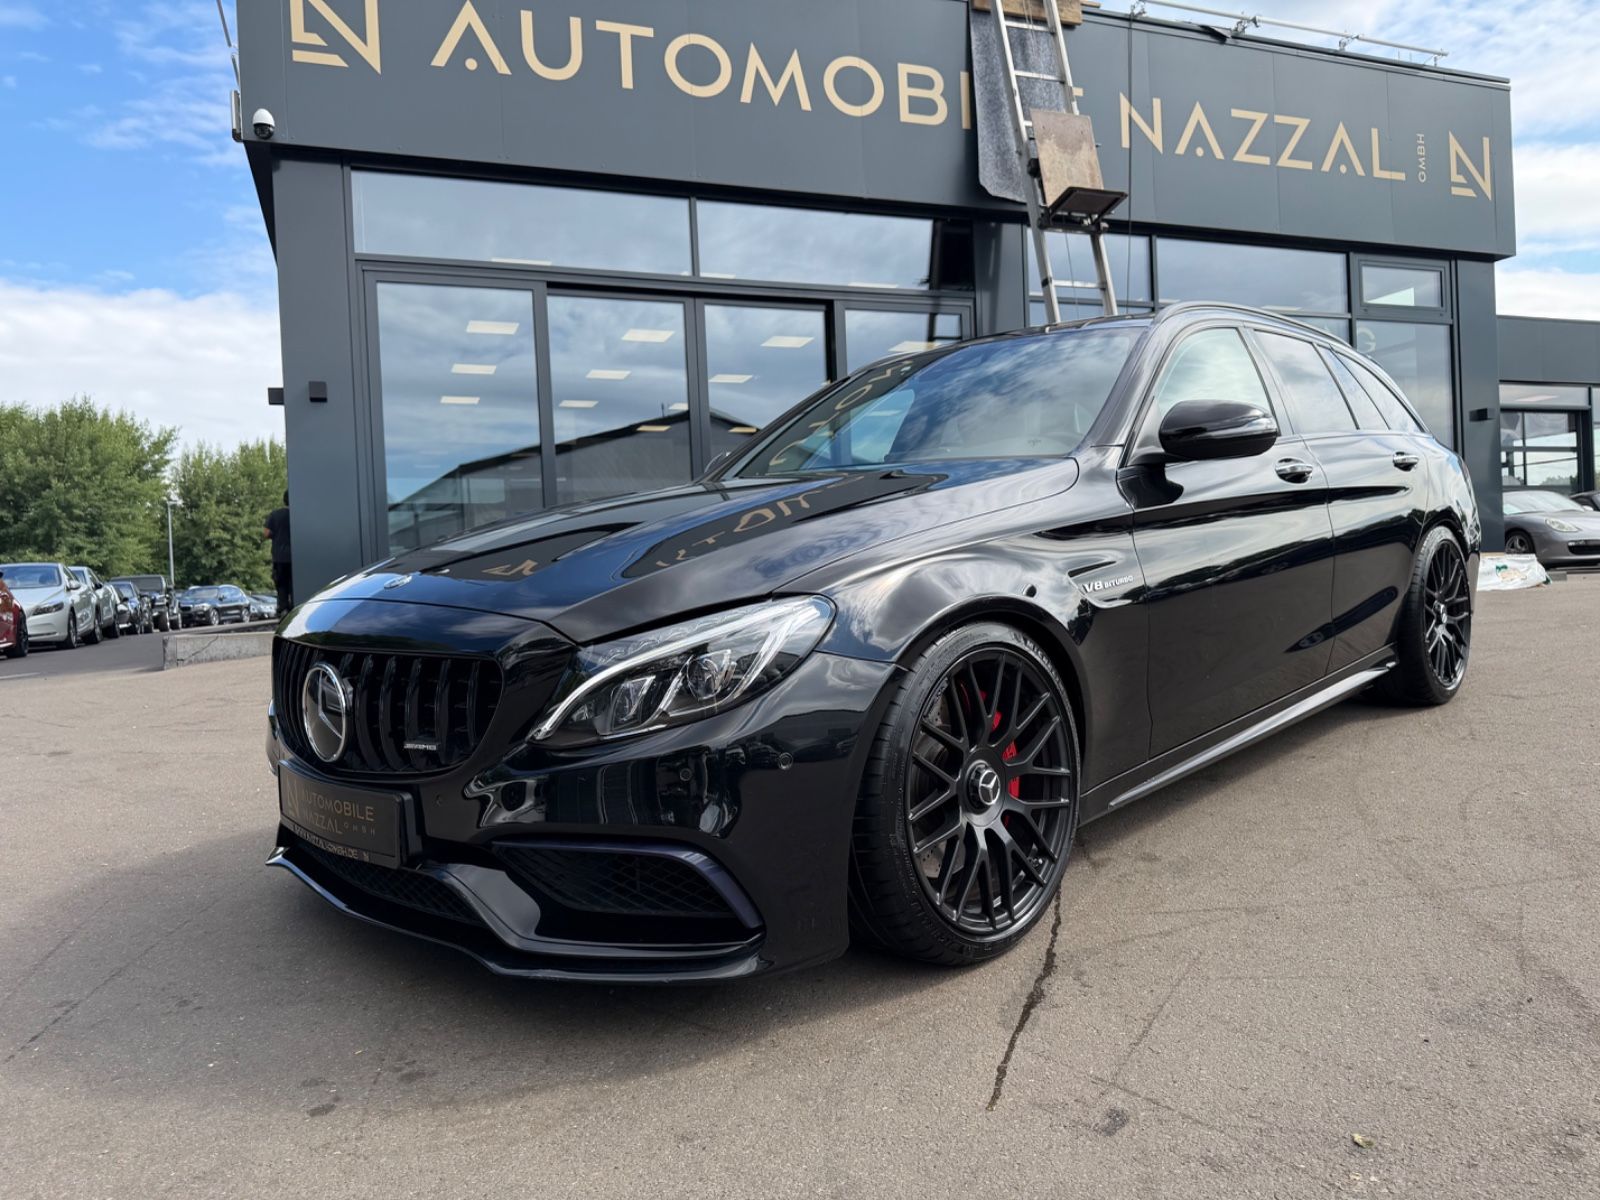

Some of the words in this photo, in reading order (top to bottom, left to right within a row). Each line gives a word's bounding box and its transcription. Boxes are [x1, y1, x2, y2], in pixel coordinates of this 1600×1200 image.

[430, 0, 1083, 130] AUTOMOBI
[1119, 92, 1406, 181] NAZZAL
[1416, 133, 1426, 183] GMBH
[1083, 581, 1103, 593] V8
[1104, 575, 1134, 588] BITURBO
[302, 788, 375, 822] AUTOMOBILE
[302, 808, 343, 835] NAZZAL
